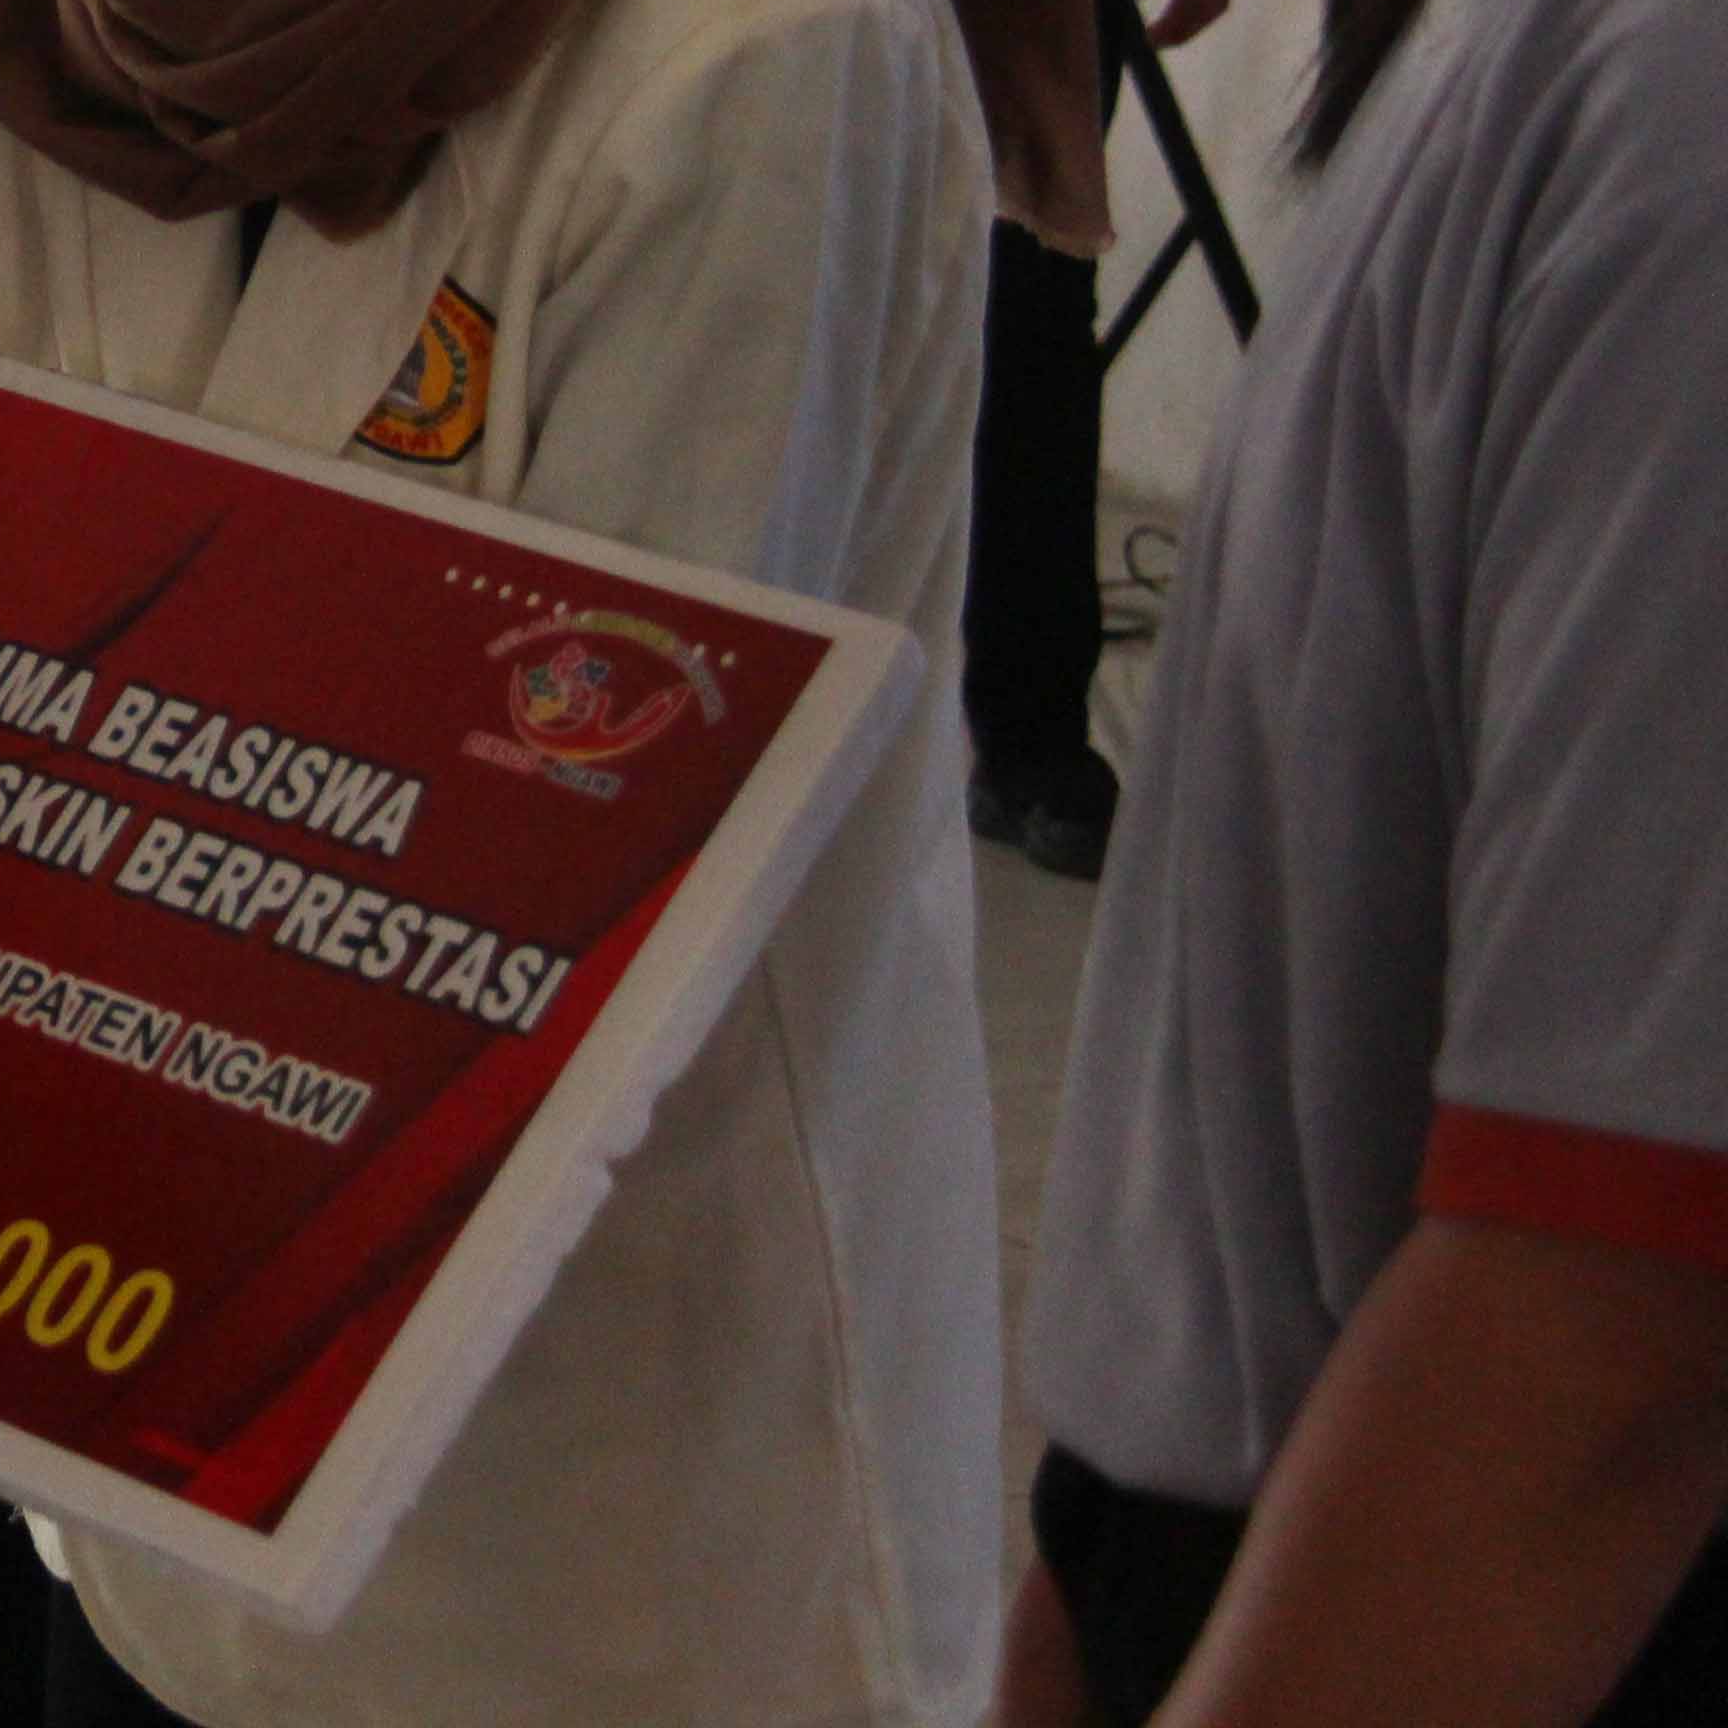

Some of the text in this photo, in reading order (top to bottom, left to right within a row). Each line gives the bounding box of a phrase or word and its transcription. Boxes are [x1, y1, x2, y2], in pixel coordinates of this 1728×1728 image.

[87, 685, 421, 856] BEASISWA
[114, 817, 572, 1033] BERPRESTASI
[166, 1027, 369, 1141] NGAWI
